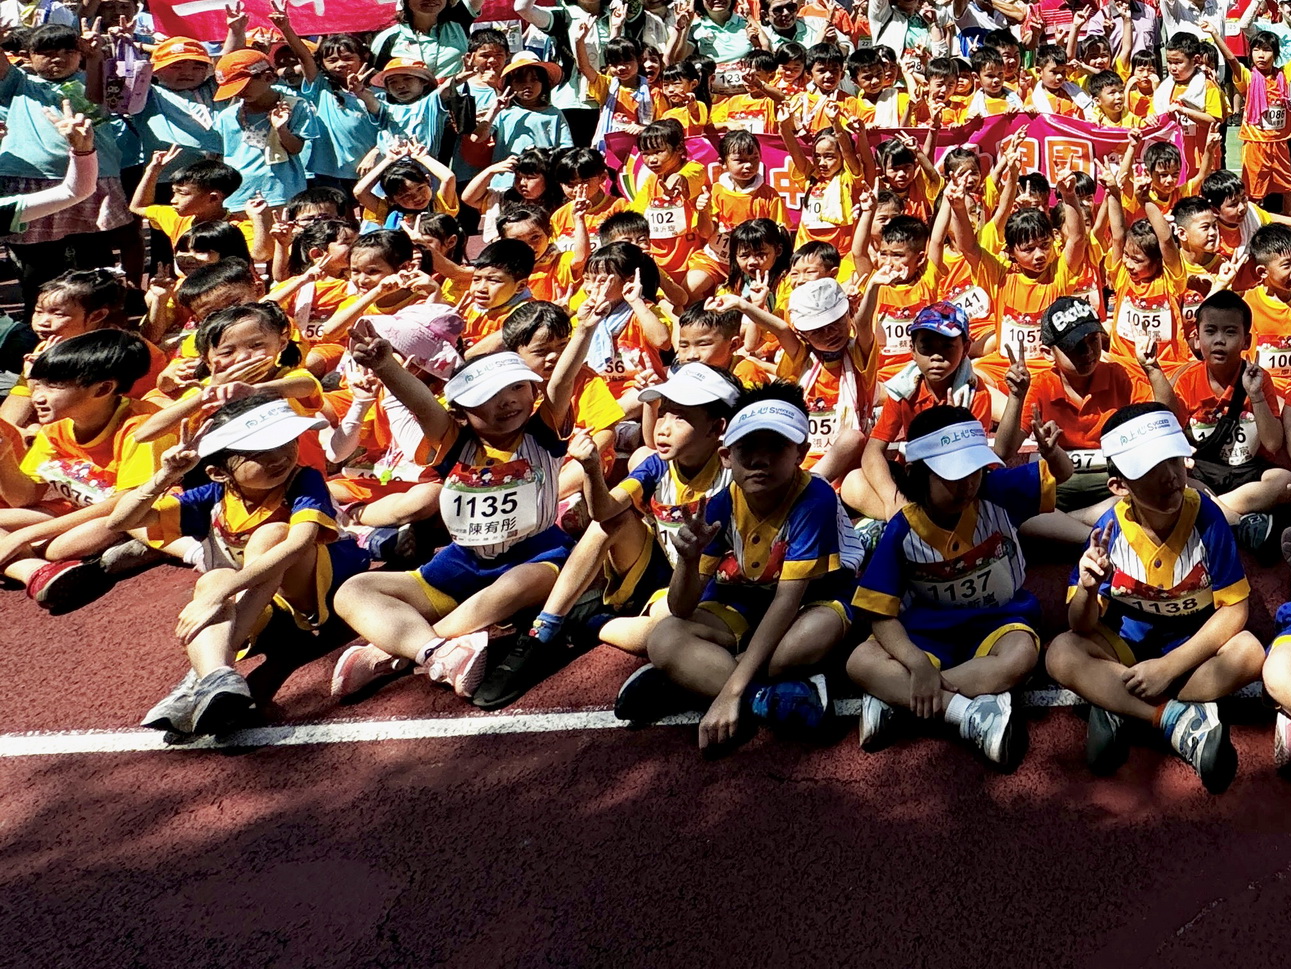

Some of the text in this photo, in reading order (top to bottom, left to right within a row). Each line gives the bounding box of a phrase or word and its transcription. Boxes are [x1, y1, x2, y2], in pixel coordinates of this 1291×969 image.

[453, 491, 518, 518] 1135
[927, 569, 992, 602] 1137
[1132, 598, 1198, 614] 1138
